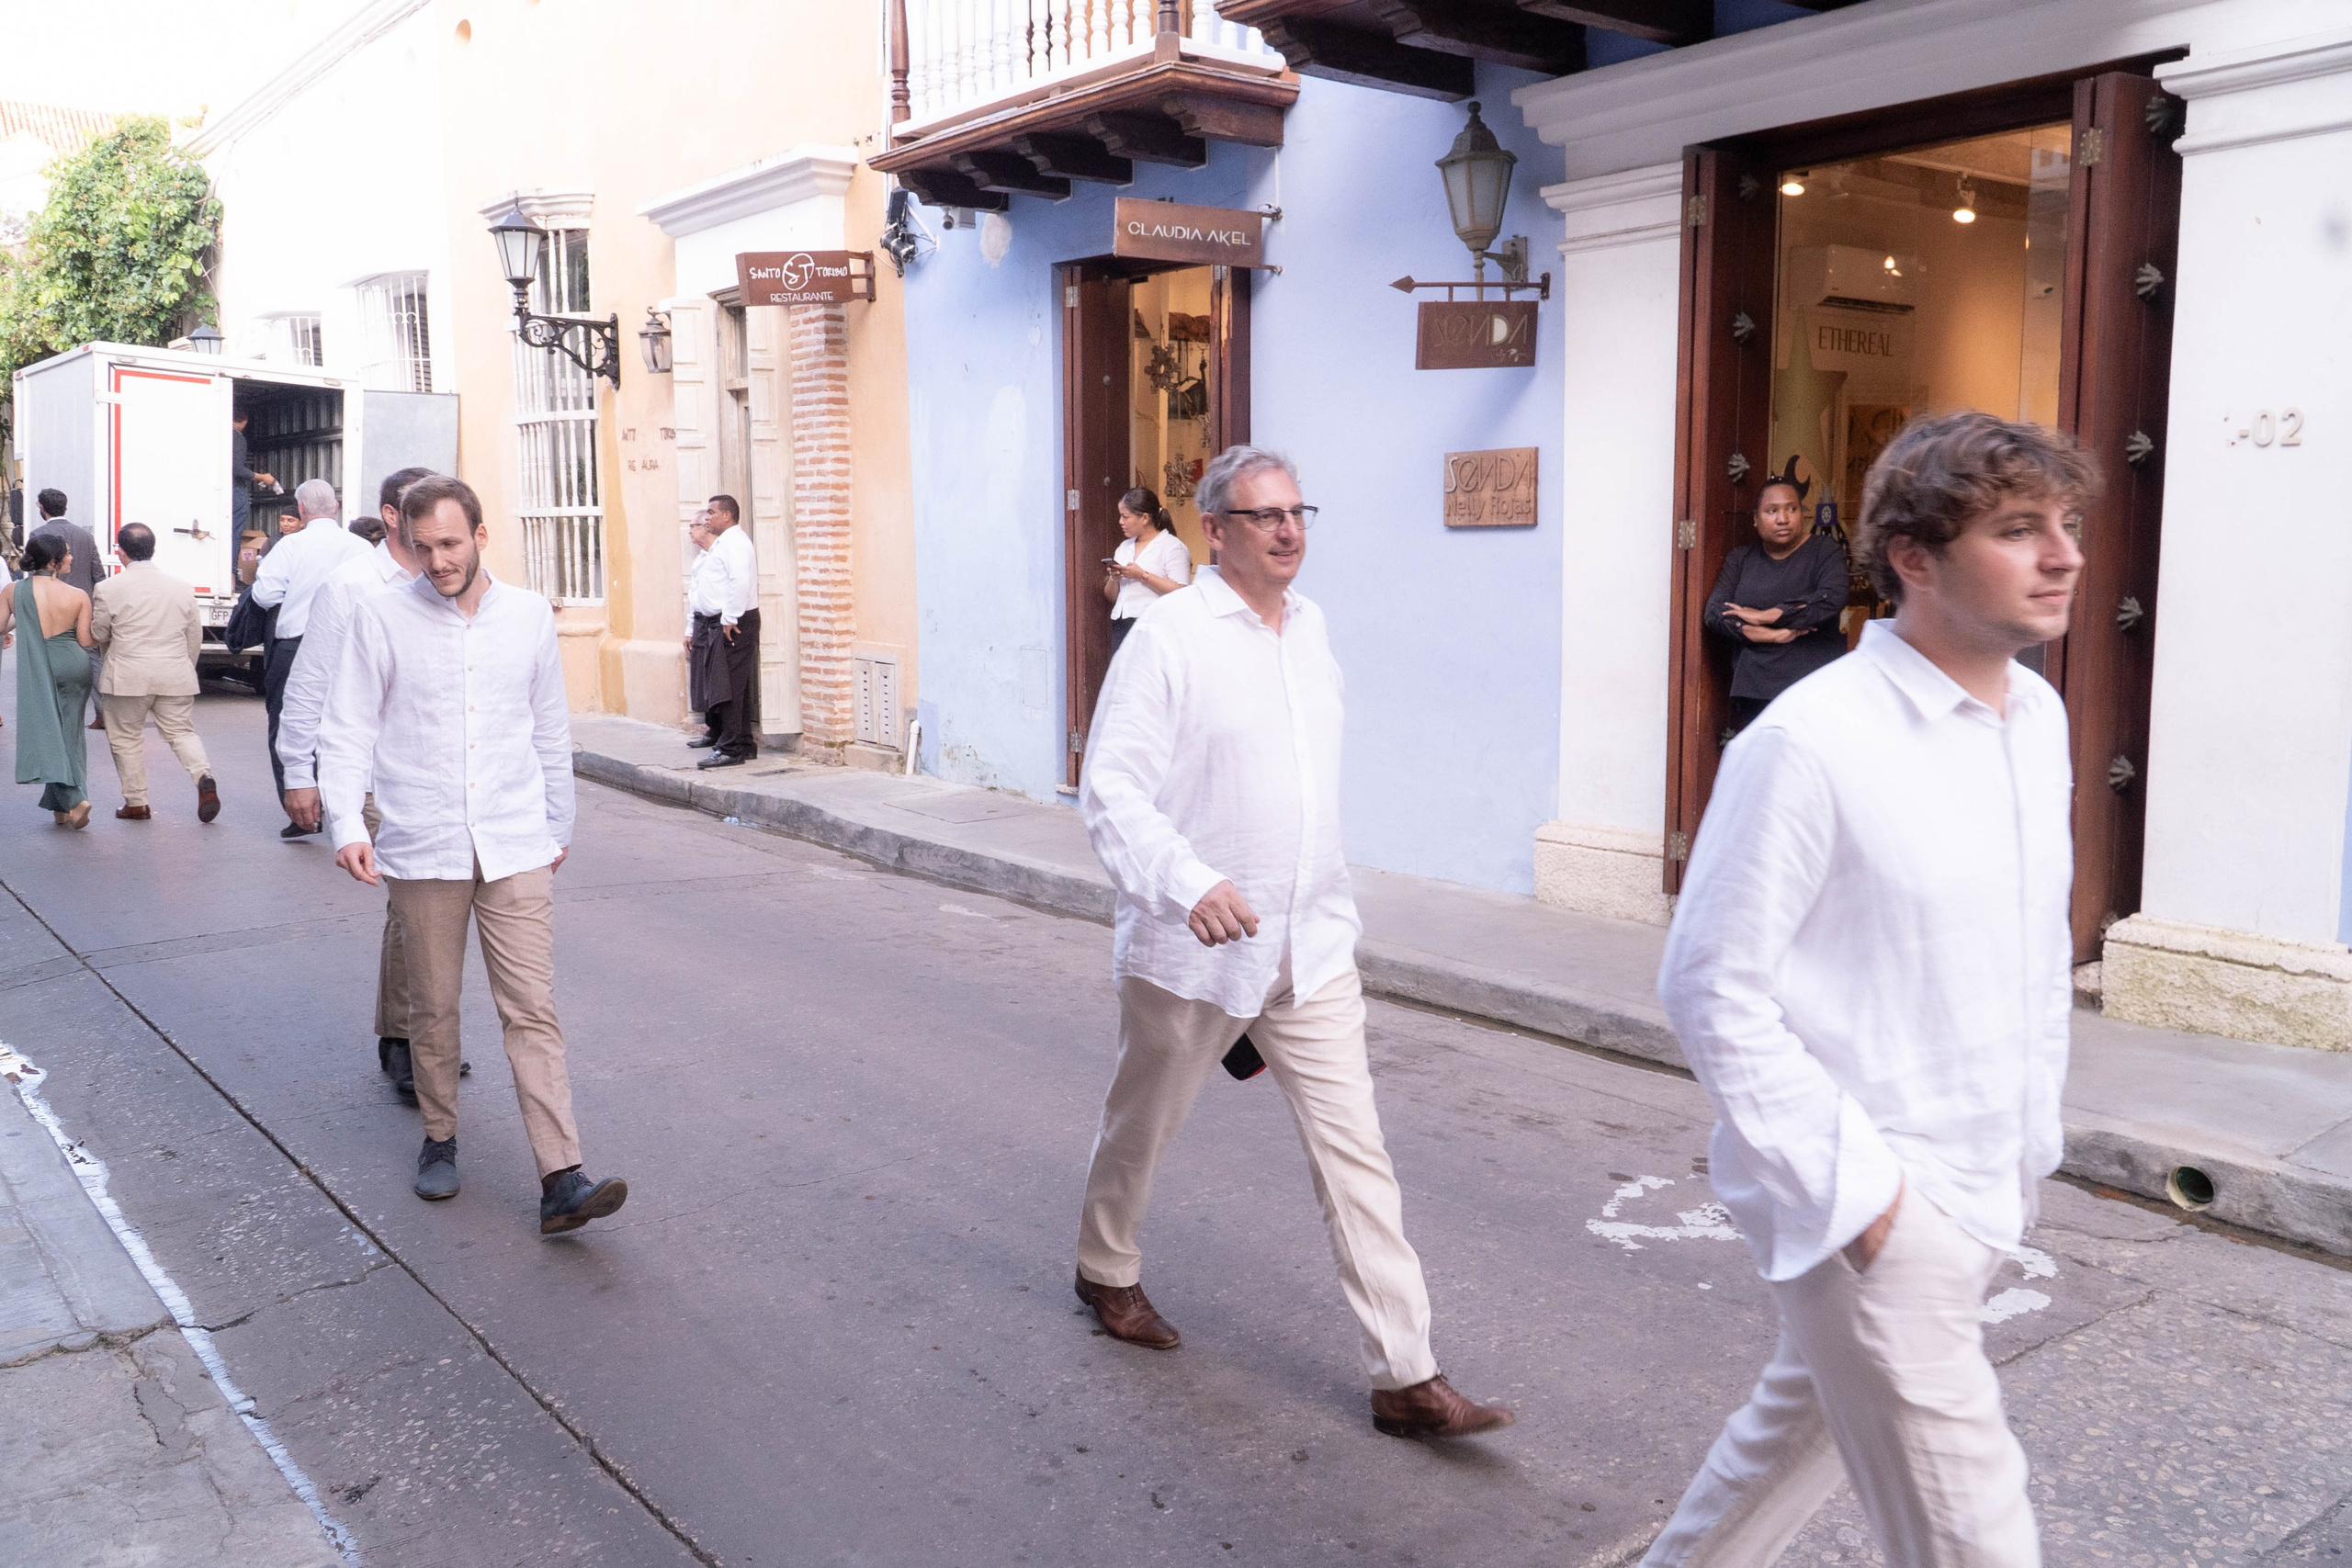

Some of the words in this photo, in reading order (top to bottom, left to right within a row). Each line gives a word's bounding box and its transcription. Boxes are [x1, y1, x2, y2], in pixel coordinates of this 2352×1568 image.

[1127, 220, 1203, 241] CLAUDIA
[1206, 230, 1251, 246] AKEL
[749, 266, 781, 279] SANTO
[815, 265, 848, 277] TORIBIO
[770, 291, 833, 303] RESTAURANTE
[1818, 325, 1894, 357] ETHEREAL
[1445, 495, 1486, 521] Nelly
